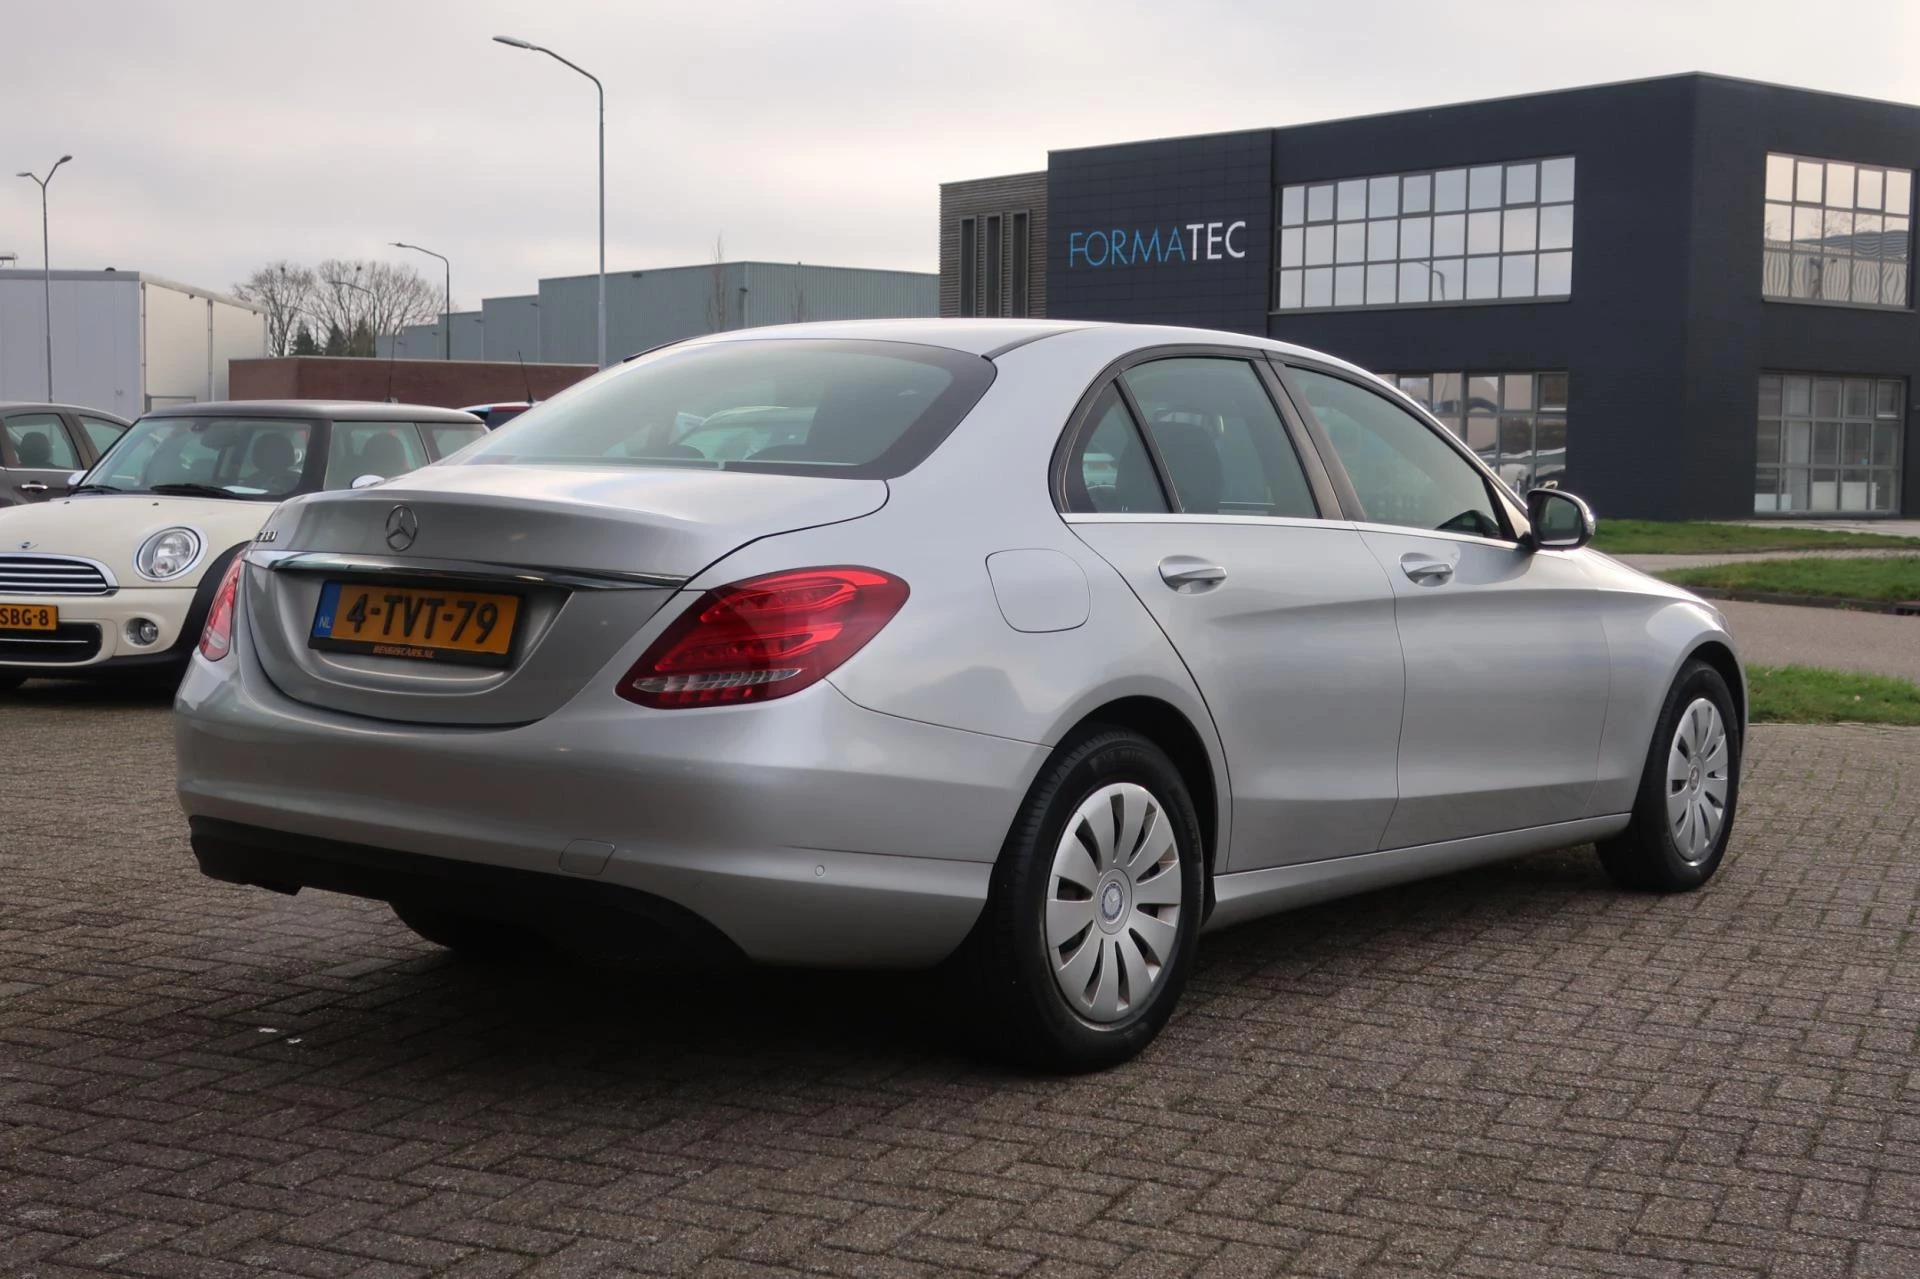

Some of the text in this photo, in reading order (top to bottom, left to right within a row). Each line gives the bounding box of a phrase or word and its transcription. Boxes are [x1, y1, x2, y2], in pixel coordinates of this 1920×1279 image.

[1070, 221, 1246, 268] FORMATEC
[318, 615, 331, 629] NL
[346, 592, 499, 645] 4-TVT-79
